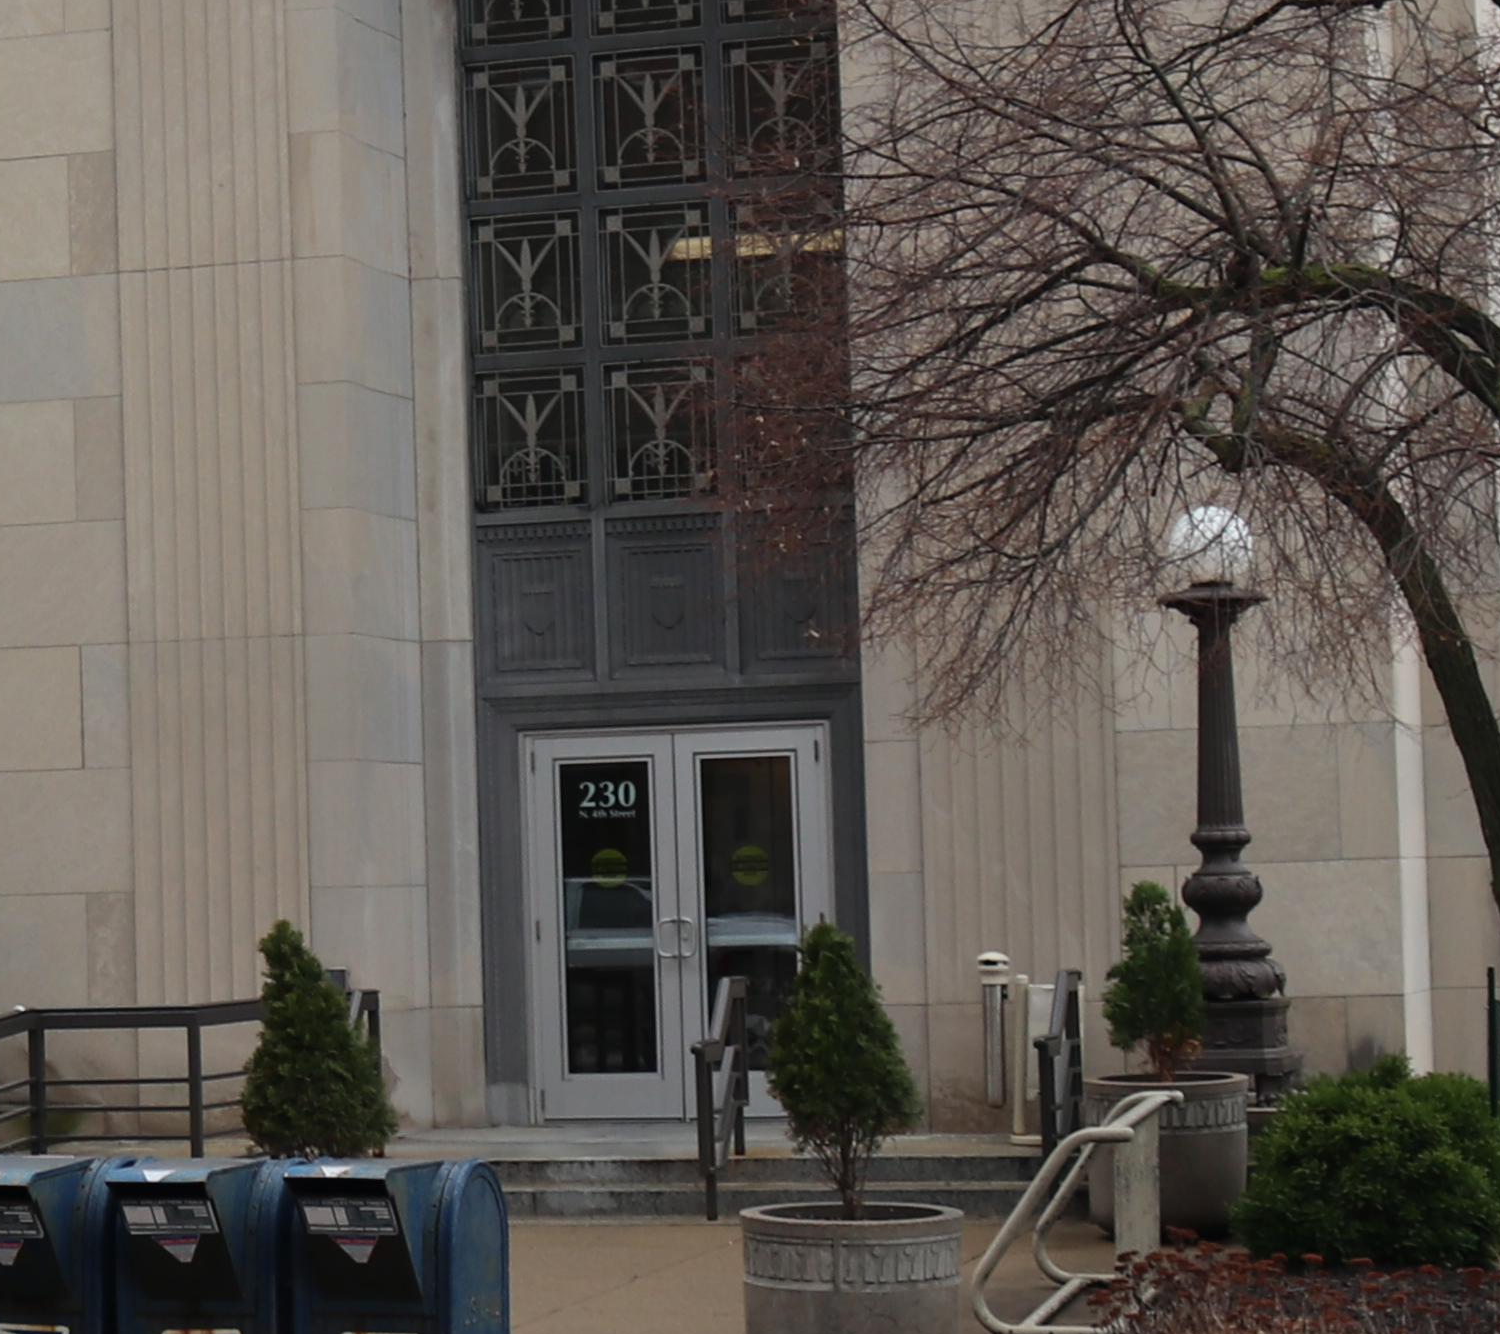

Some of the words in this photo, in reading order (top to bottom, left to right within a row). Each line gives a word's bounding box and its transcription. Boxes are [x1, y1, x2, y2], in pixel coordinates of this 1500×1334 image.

[579, 780, 636, 808] 230
[592, 809, 607, 818] 4th
[609, 809, 636, 818] Street
